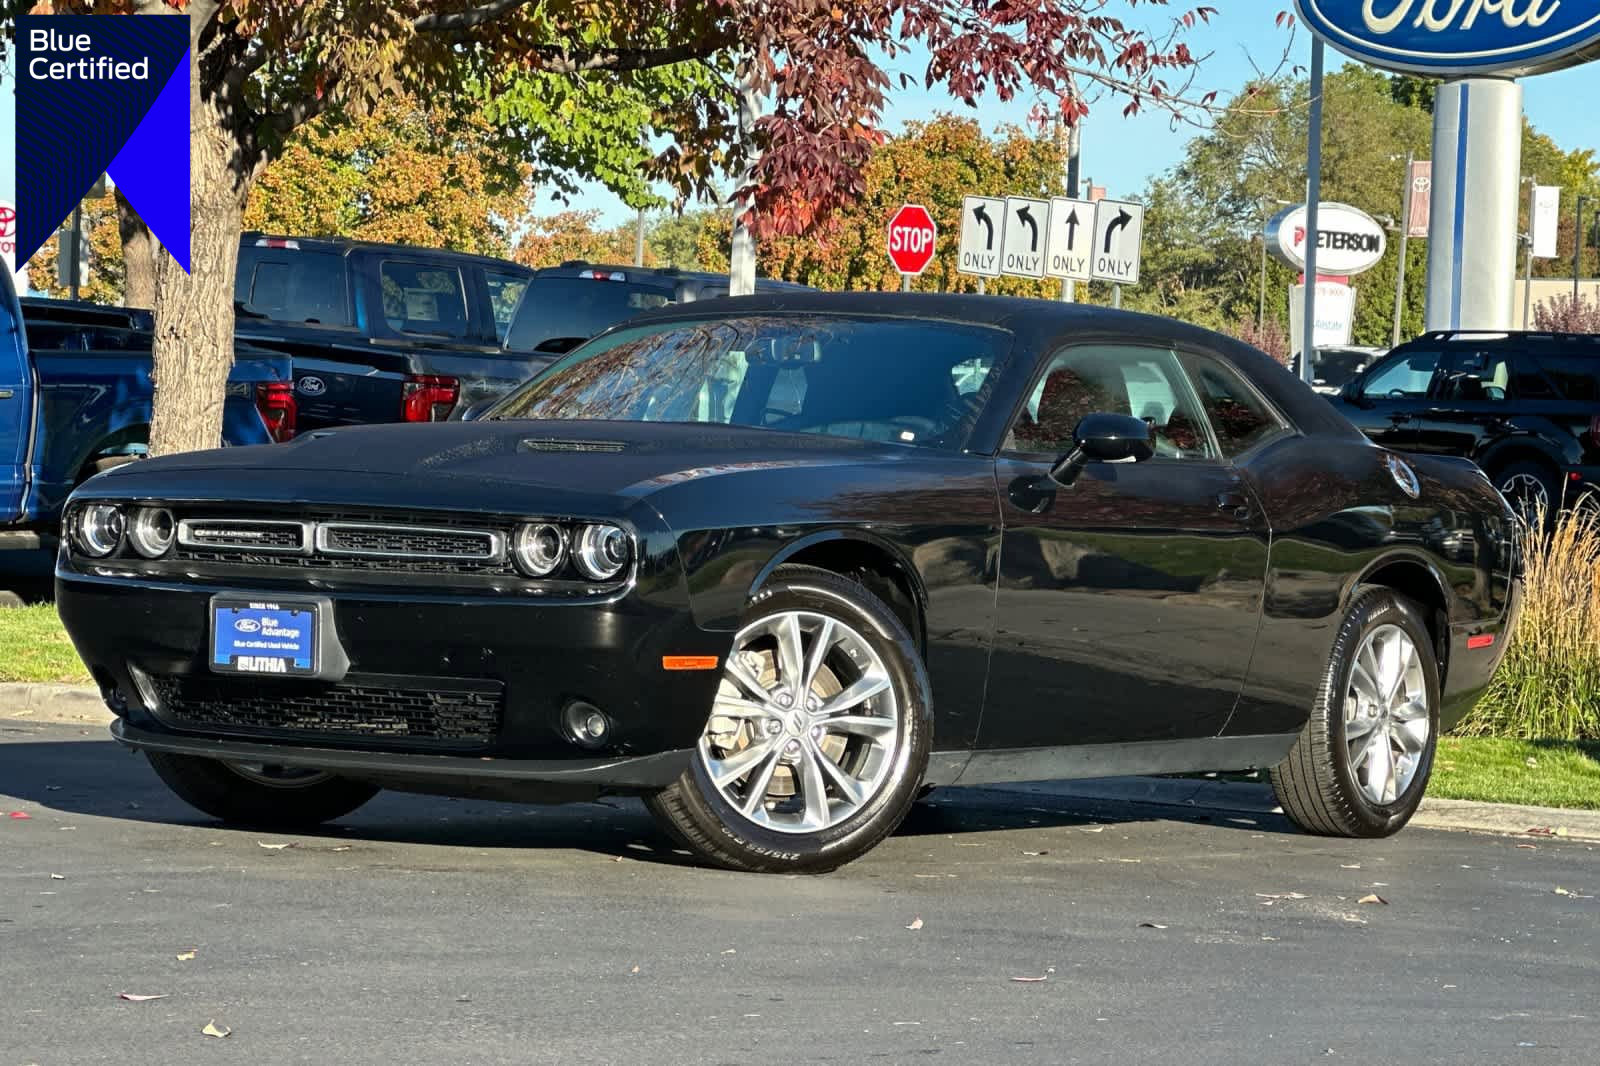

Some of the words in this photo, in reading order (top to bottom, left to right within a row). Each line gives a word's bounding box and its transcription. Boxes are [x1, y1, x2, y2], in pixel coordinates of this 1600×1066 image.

[891, 226, 933, 253] STOP
[963, 251, 995, 270] ONLY
[1007, 253, 1039, 272] ONLY
[1053, 255, 1085, 273] ONLY
[1098, 257, 1132, 277] ONLY
[261, 617, 279, 627] Blue
[261, 628, 300, 639] Advantage
[233, 640, 246, 648] Blue
[248, 655, 287, 673] LITHIA
